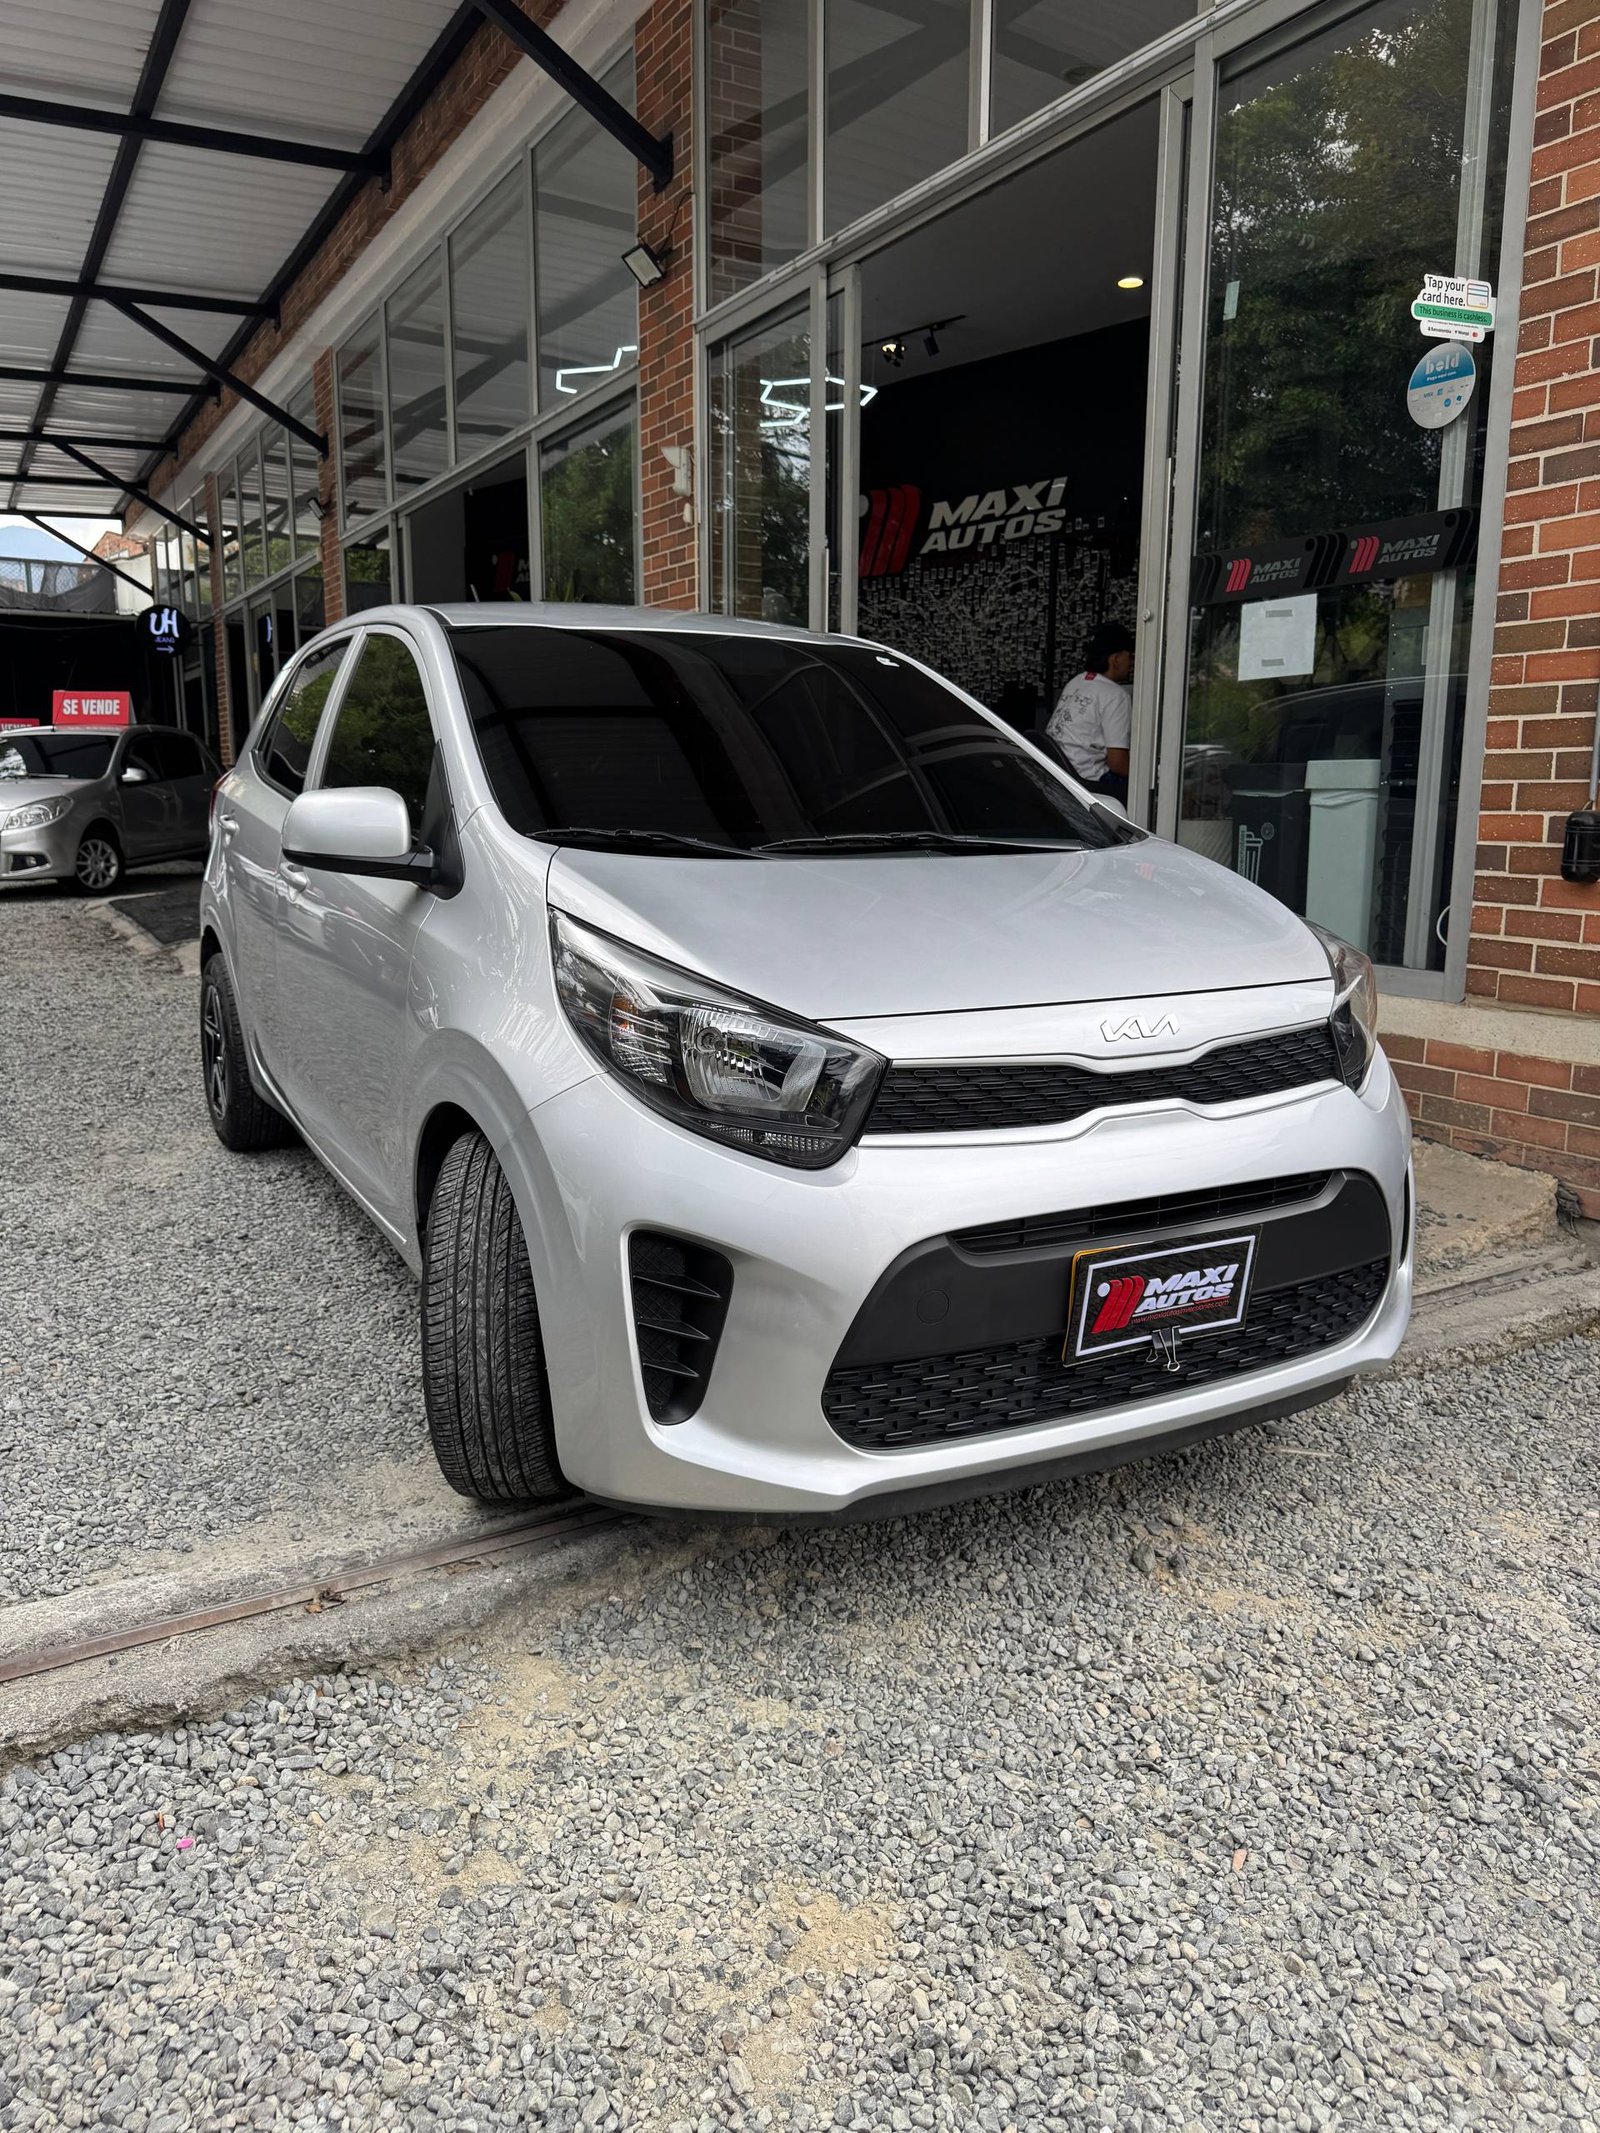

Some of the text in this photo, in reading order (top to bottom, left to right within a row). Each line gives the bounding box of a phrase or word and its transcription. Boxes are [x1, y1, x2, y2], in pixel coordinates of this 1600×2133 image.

[1427, 276, 1465, 292] Tap your
[1422, 292, 1466, 307] card here.
[1420, 306, 1431, 315] This
[1432, 309, 1457, 319] business
[1463, 313, 1488, 322] cashless.
[1425, 352, 1460, 375] bold
[928, 476, 1068, 530] MAXI
[920, 508, 1067, 554] AUTOS
[1381, 534, 1440, 554] MAXI
[1377, 546, 1438, 564] AUTOS
[1252, 557, 1302, 575] MAXI
[1250, 568, 1300, 585] AUTOS
[62, 699, 120, 716] SE VENDE
[1143, 1263, 1240, 1297] MAXI
[1134, 1282, 1234, 1314] AUTOS
